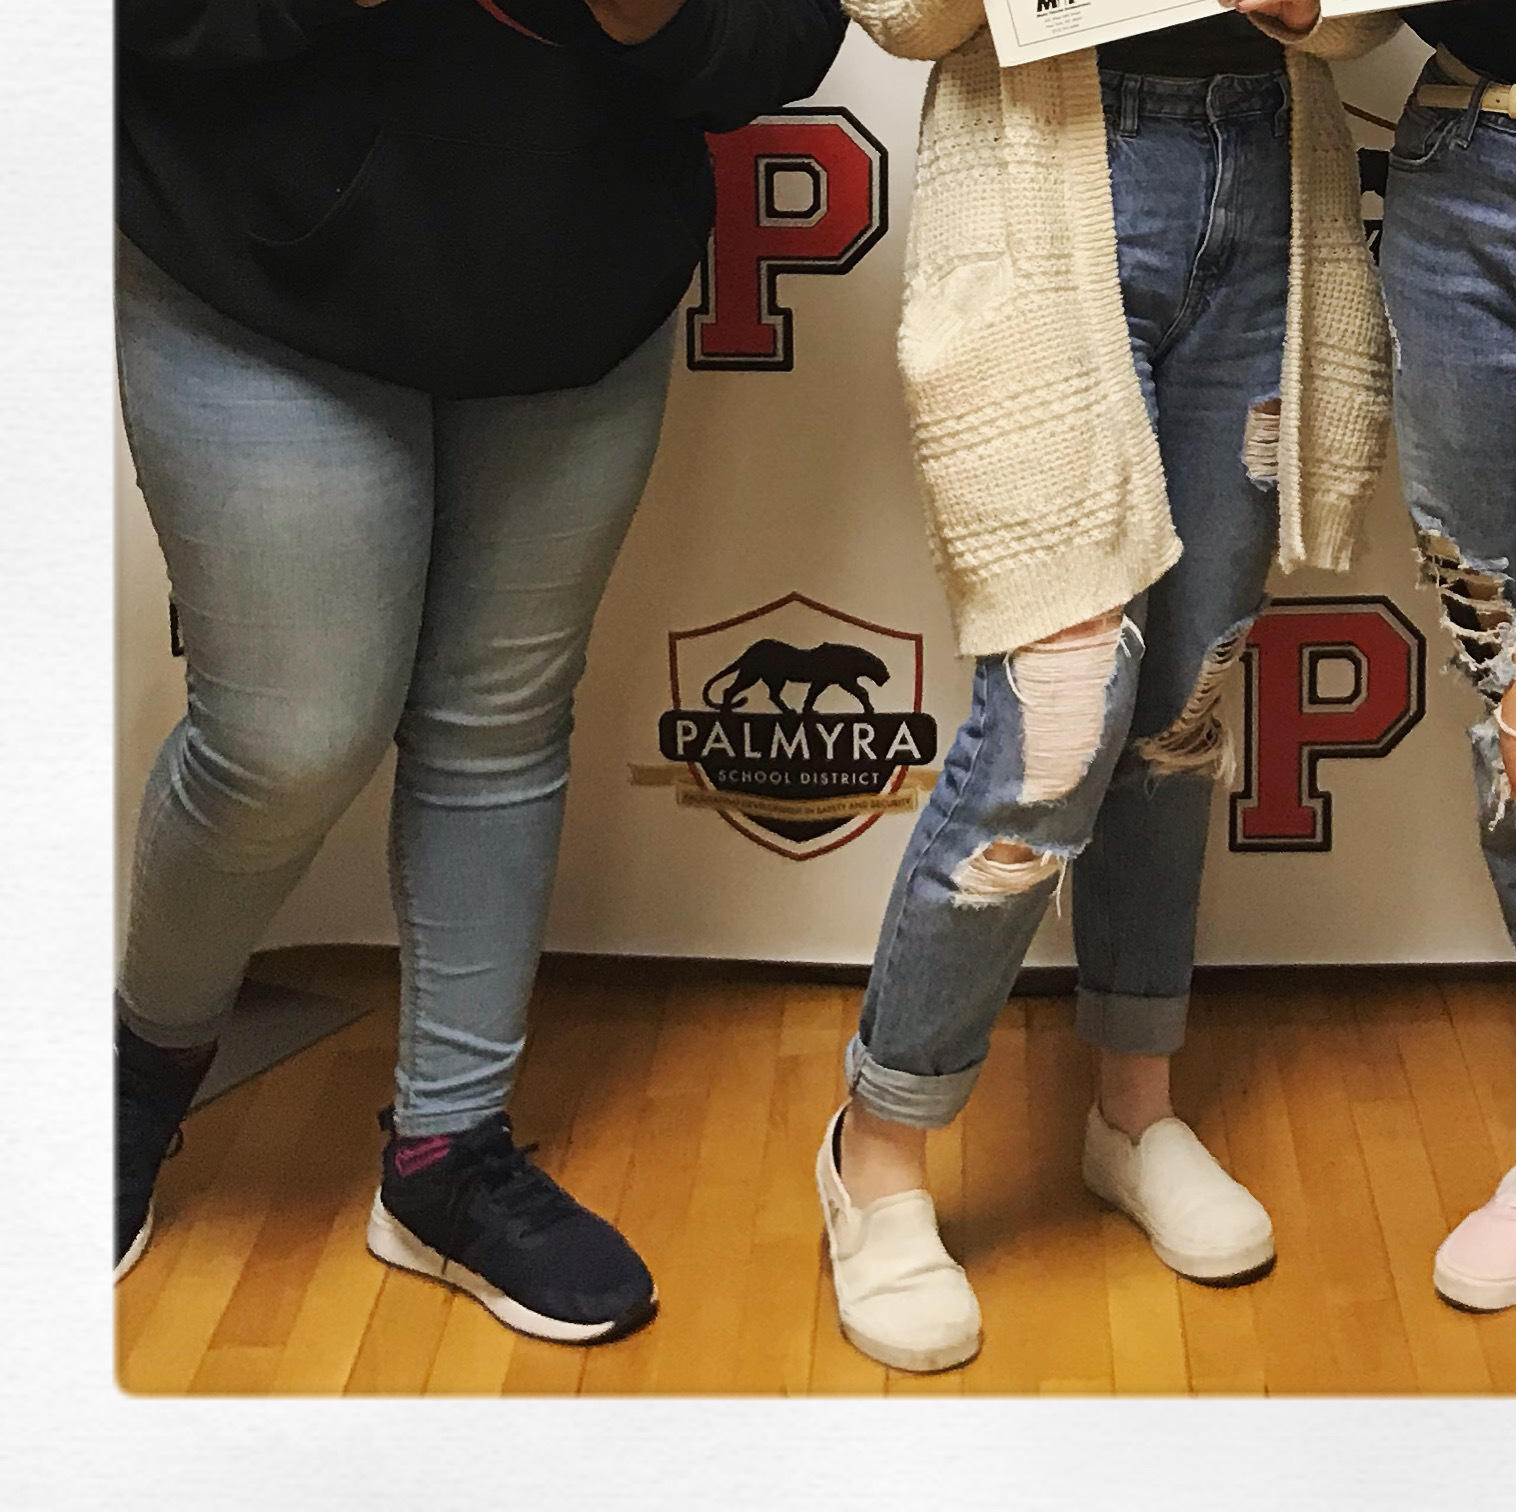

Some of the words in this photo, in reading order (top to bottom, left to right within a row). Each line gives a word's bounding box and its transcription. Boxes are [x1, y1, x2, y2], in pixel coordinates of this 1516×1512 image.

[686, 106, 889, 370] P
[676, 719, 922, 761] PALMYRA
[718, 769, 792, 784] SCHOOL
[800, 770, 880, 785] DISTRICT
[1228, 595, 1427, 852] P
